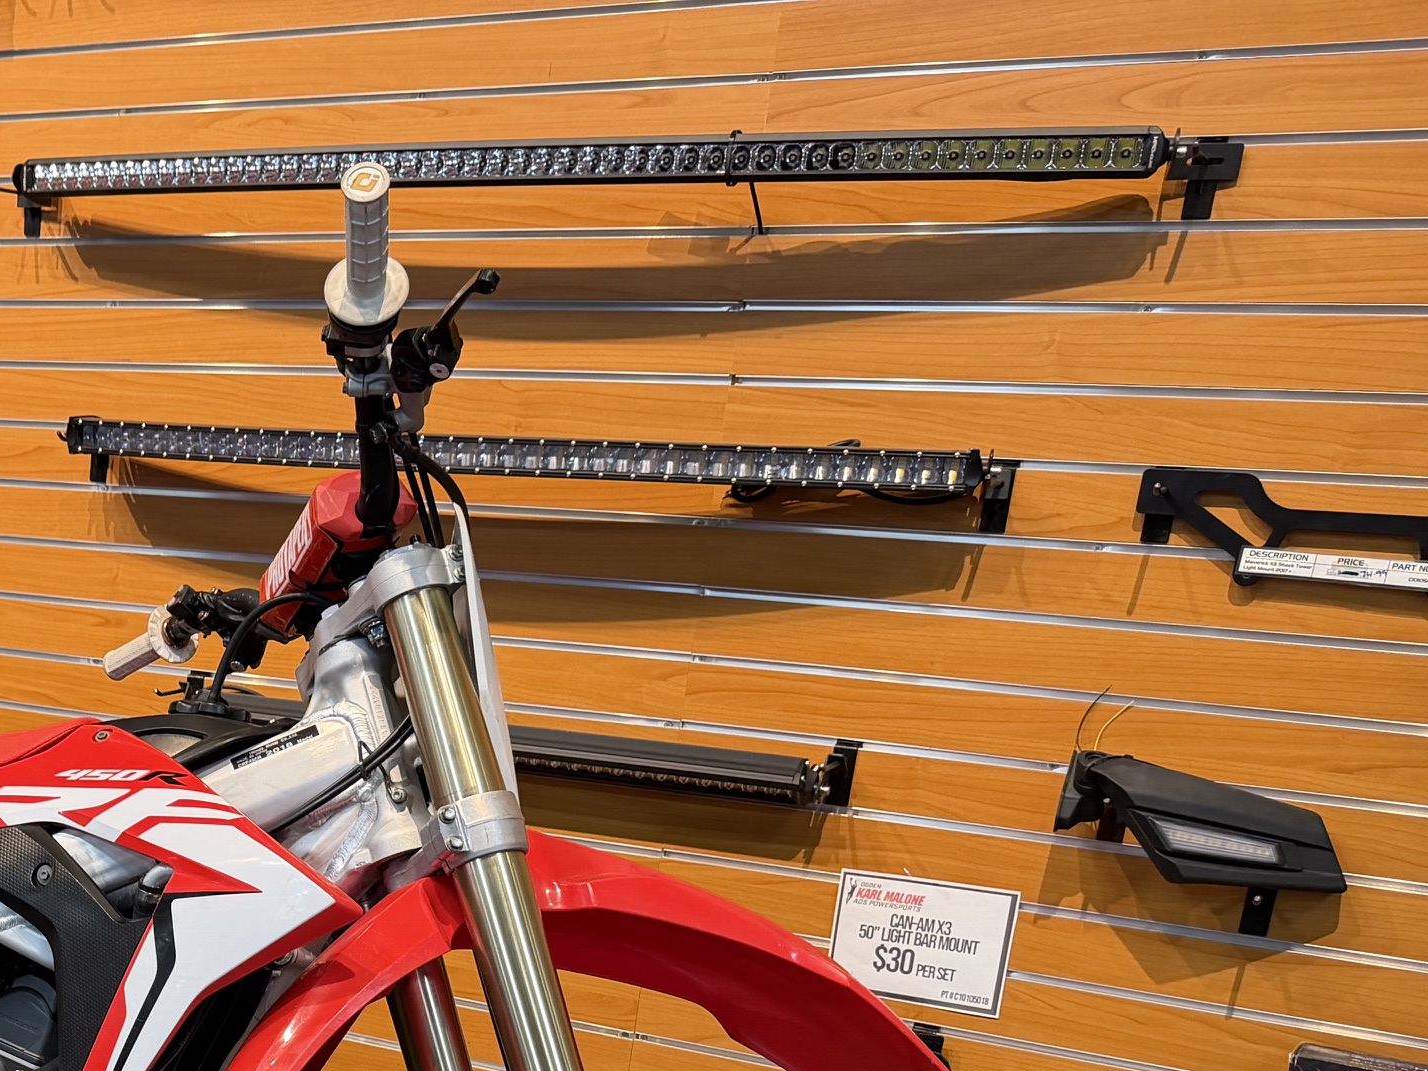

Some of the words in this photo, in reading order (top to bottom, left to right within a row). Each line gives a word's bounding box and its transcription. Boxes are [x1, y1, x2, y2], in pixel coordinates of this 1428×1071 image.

[1249, 550, 1310, 561] DESCRIPTION
[1337, 557, 1365, 566] PRICE
[1392, 562, 1417, 571] PART
[265, 741, 293, 758] 2018
[860, 881, 882, 889] OGDEN
[856, 887, 882, 900] KARL
[883, 891, 926, 907] MALONE
[868, 900, 922, 913] POWERSPORTS
[890, 913, 935, 932] CAN-AM
[936, 920, 953, 936] X3
[858, 924, 880, 940] 50"
[881, 928, 913, 946] LIGHT
[913, 932, 938, 949] BAR
[938, 936, 981, 956] MOUNT
[872, 943, 916, 975] $30
[916, 963, 936, 979] PER
[936, 967, 957, 982] SET
[940, 990, 949, 999] PT
